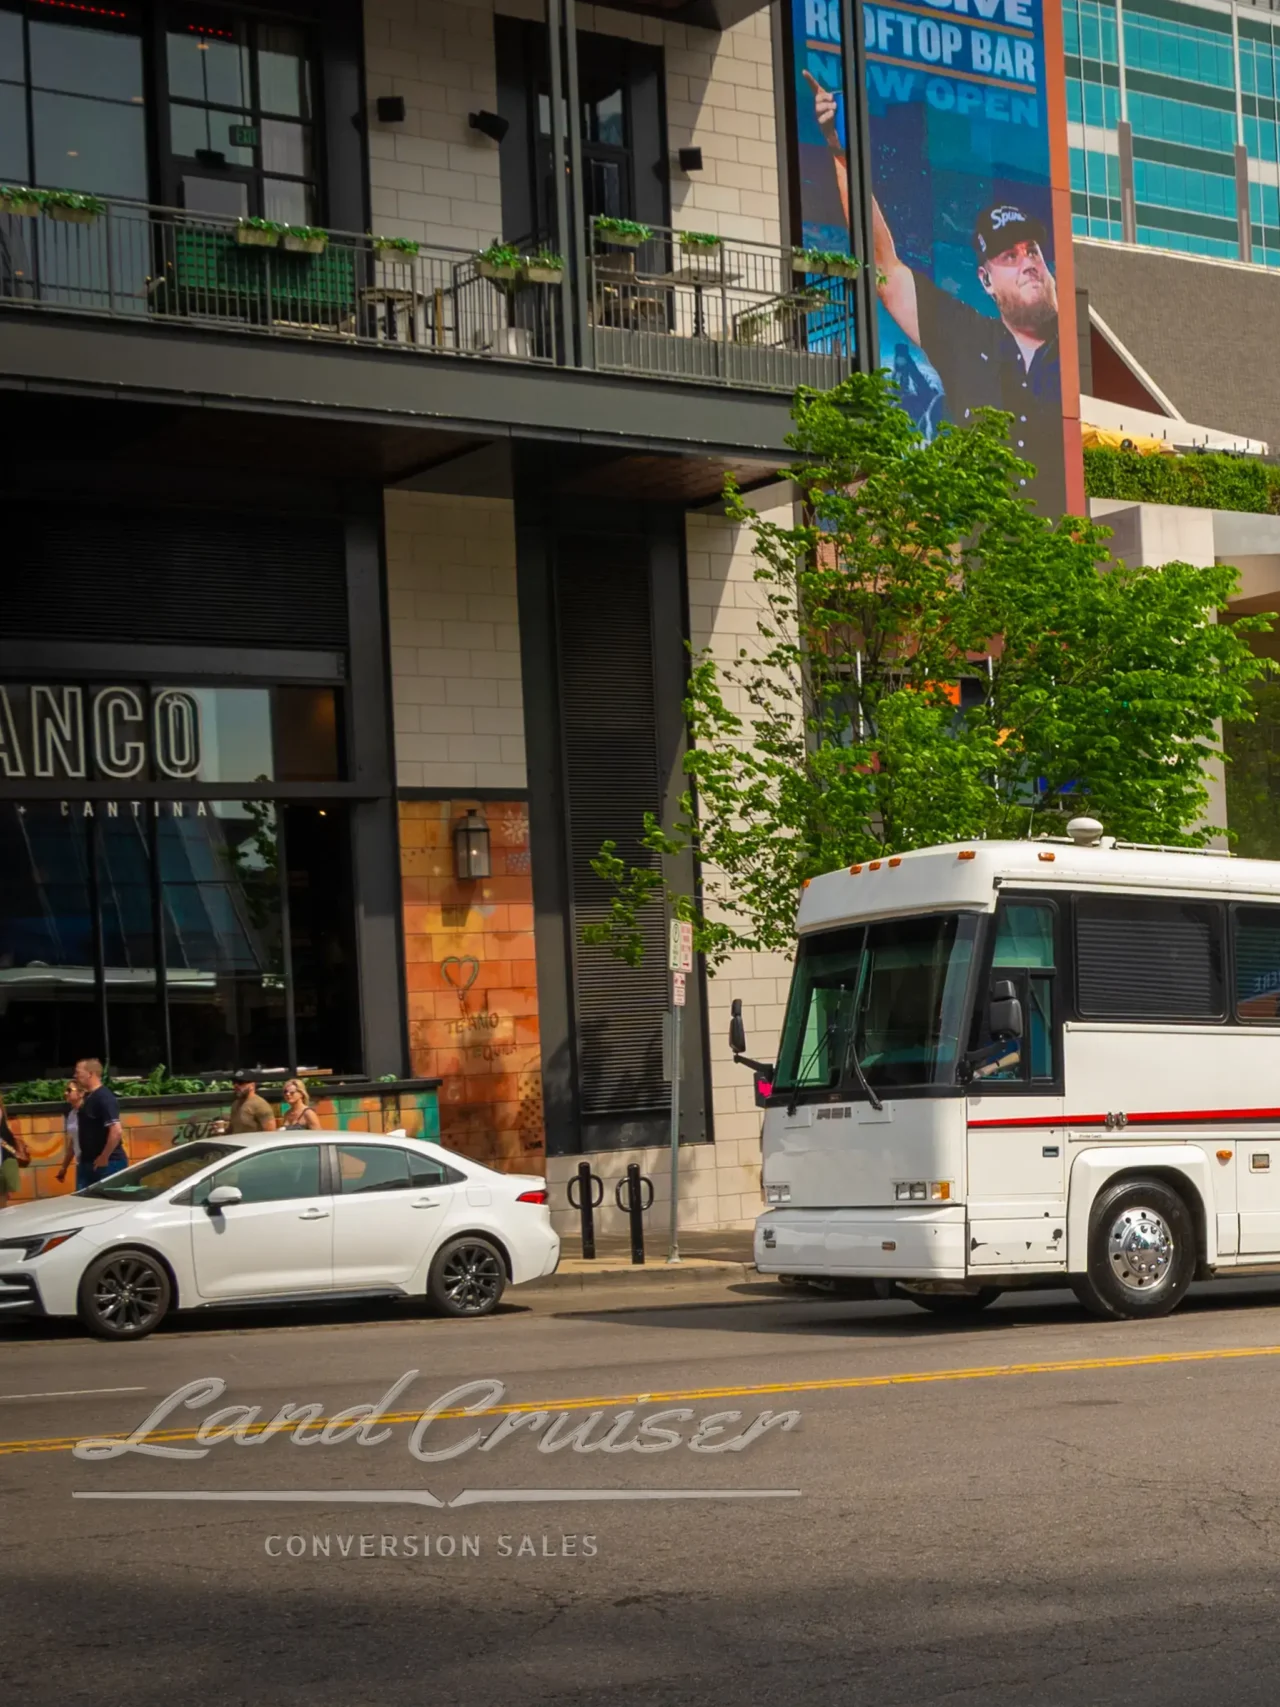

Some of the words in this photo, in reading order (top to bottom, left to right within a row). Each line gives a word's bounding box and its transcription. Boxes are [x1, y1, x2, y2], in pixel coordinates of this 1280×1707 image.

[971, 31, 1037, 82] BAR
[806, 51, 915, 102] NW
[926, 78, 1040, 128] OPEN
[60, 801, 208, 817] CANTINA
